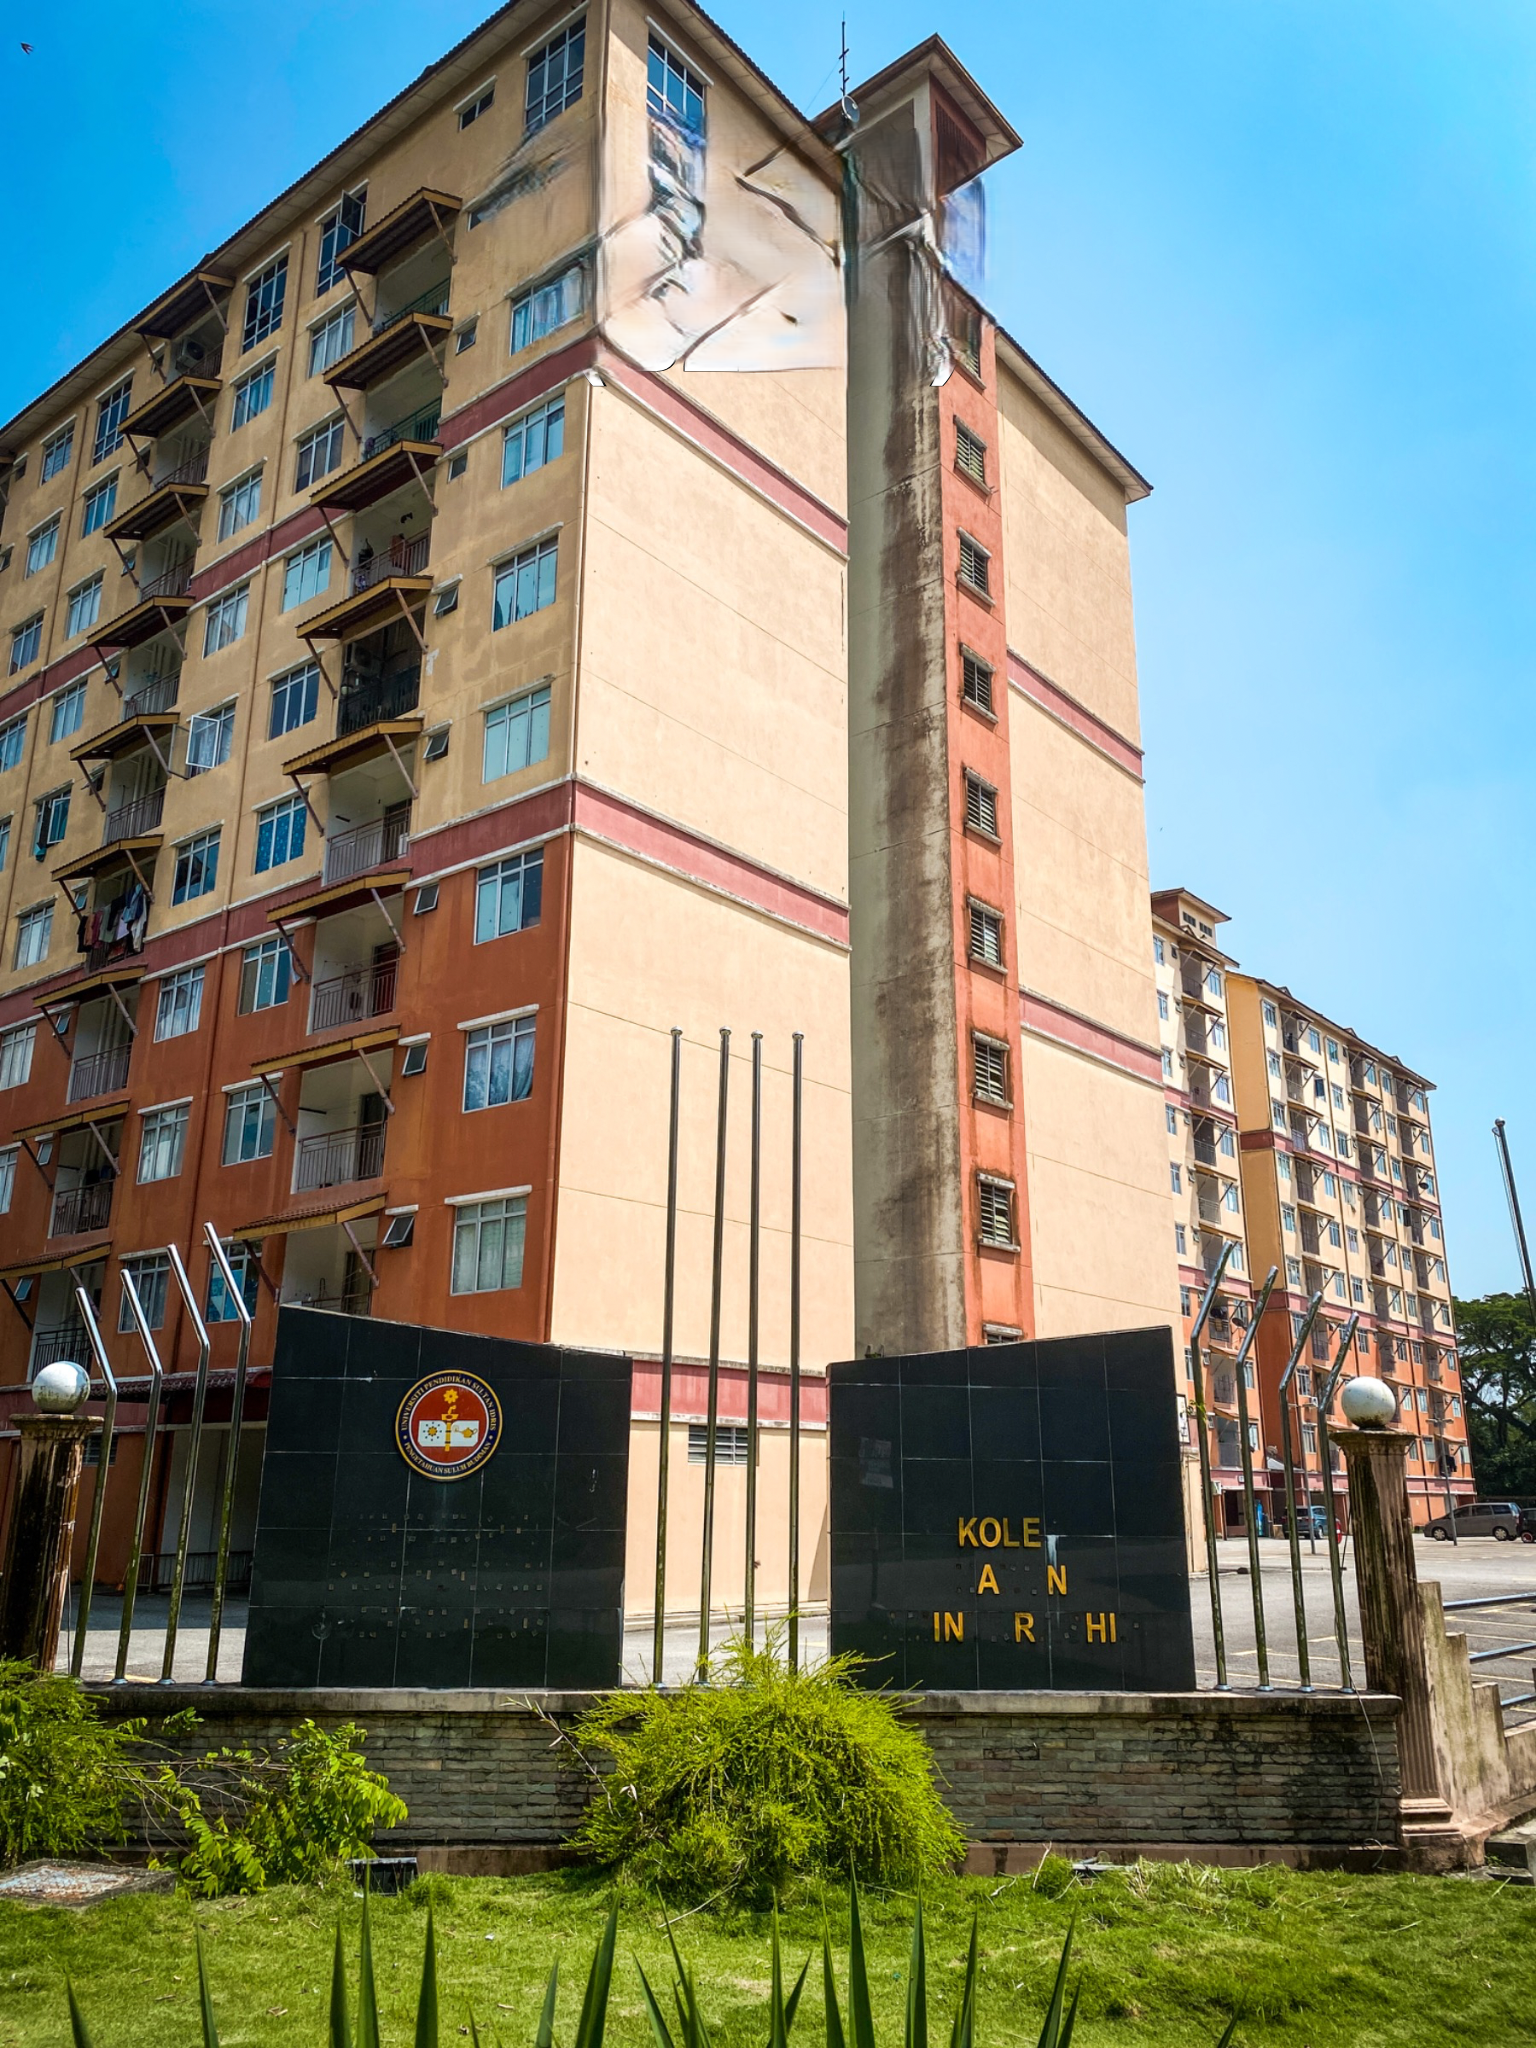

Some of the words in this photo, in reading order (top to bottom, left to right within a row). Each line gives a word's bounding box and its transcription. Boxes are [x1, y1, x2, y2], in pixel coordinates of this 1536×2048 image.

[401, 1386, 425, 1431] UNIVERSITI
[424, 1375, 472, 1390] PENDIDIKAN
[472, 1382, 492, 1409] SULTAN
[489, 1408, 497, 1431] IDRIS
[958, 1517, 1042, 1548] KOLE
